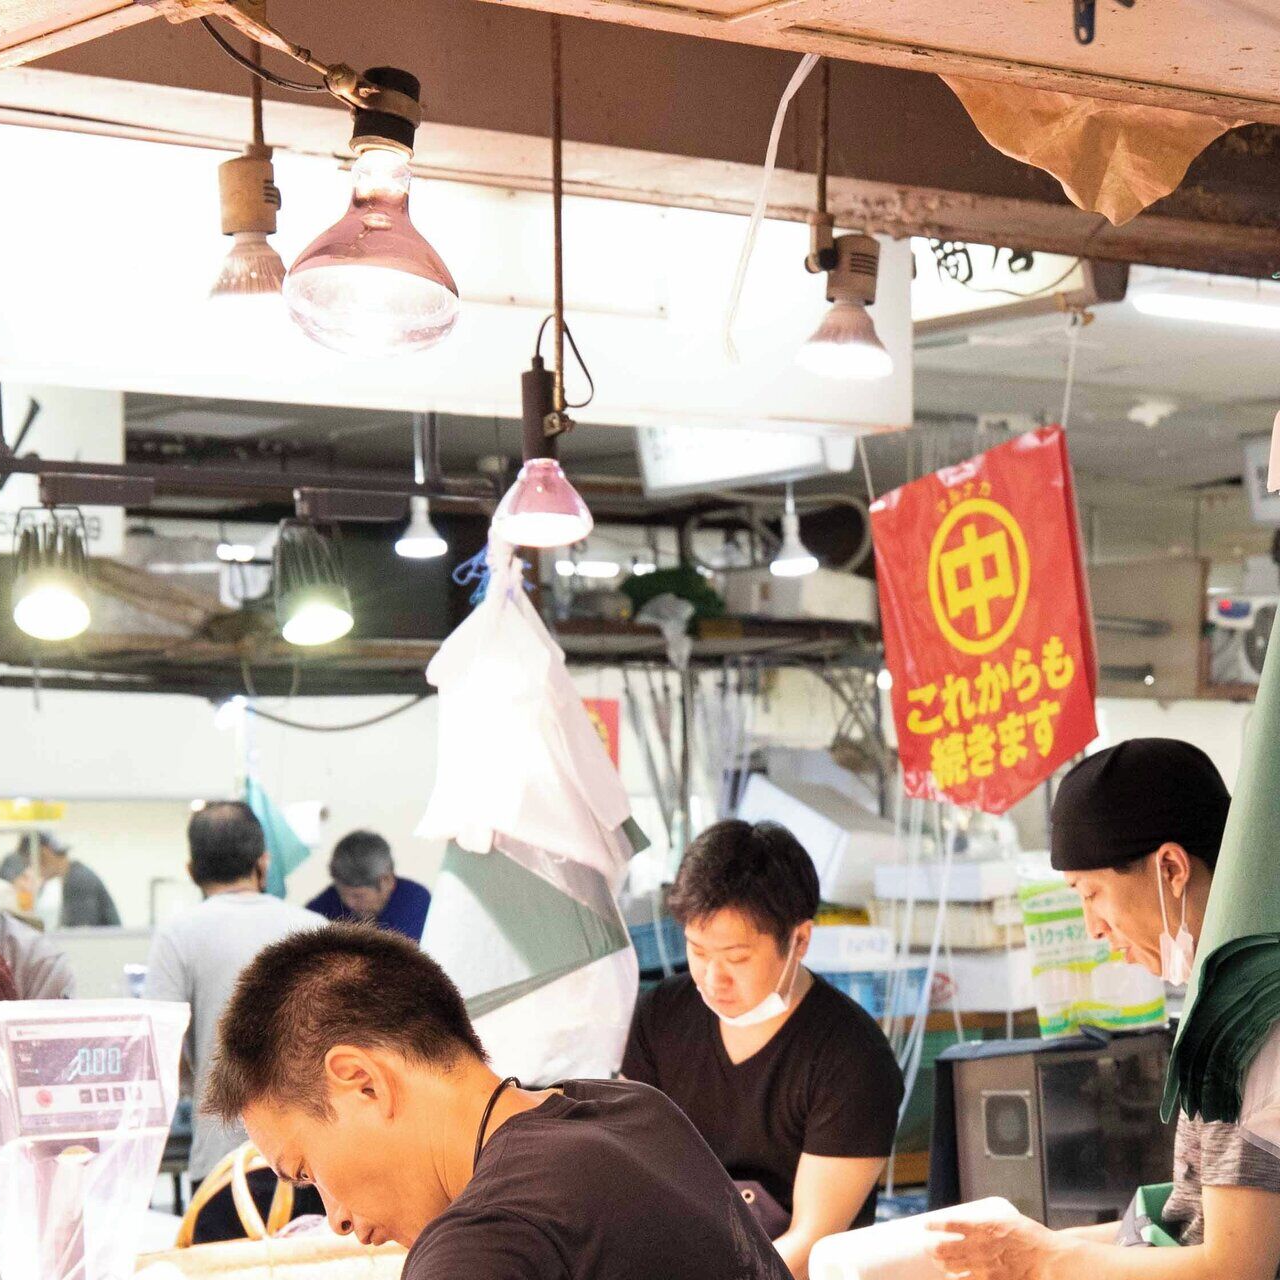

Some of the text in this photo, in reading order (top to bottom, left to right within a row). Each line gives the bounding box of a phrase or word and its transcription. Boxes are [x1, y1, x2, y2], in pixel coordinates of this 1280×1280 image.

[906, 635, 1075, 735] これからも
[930, 699, 1061, 791] 続きます
